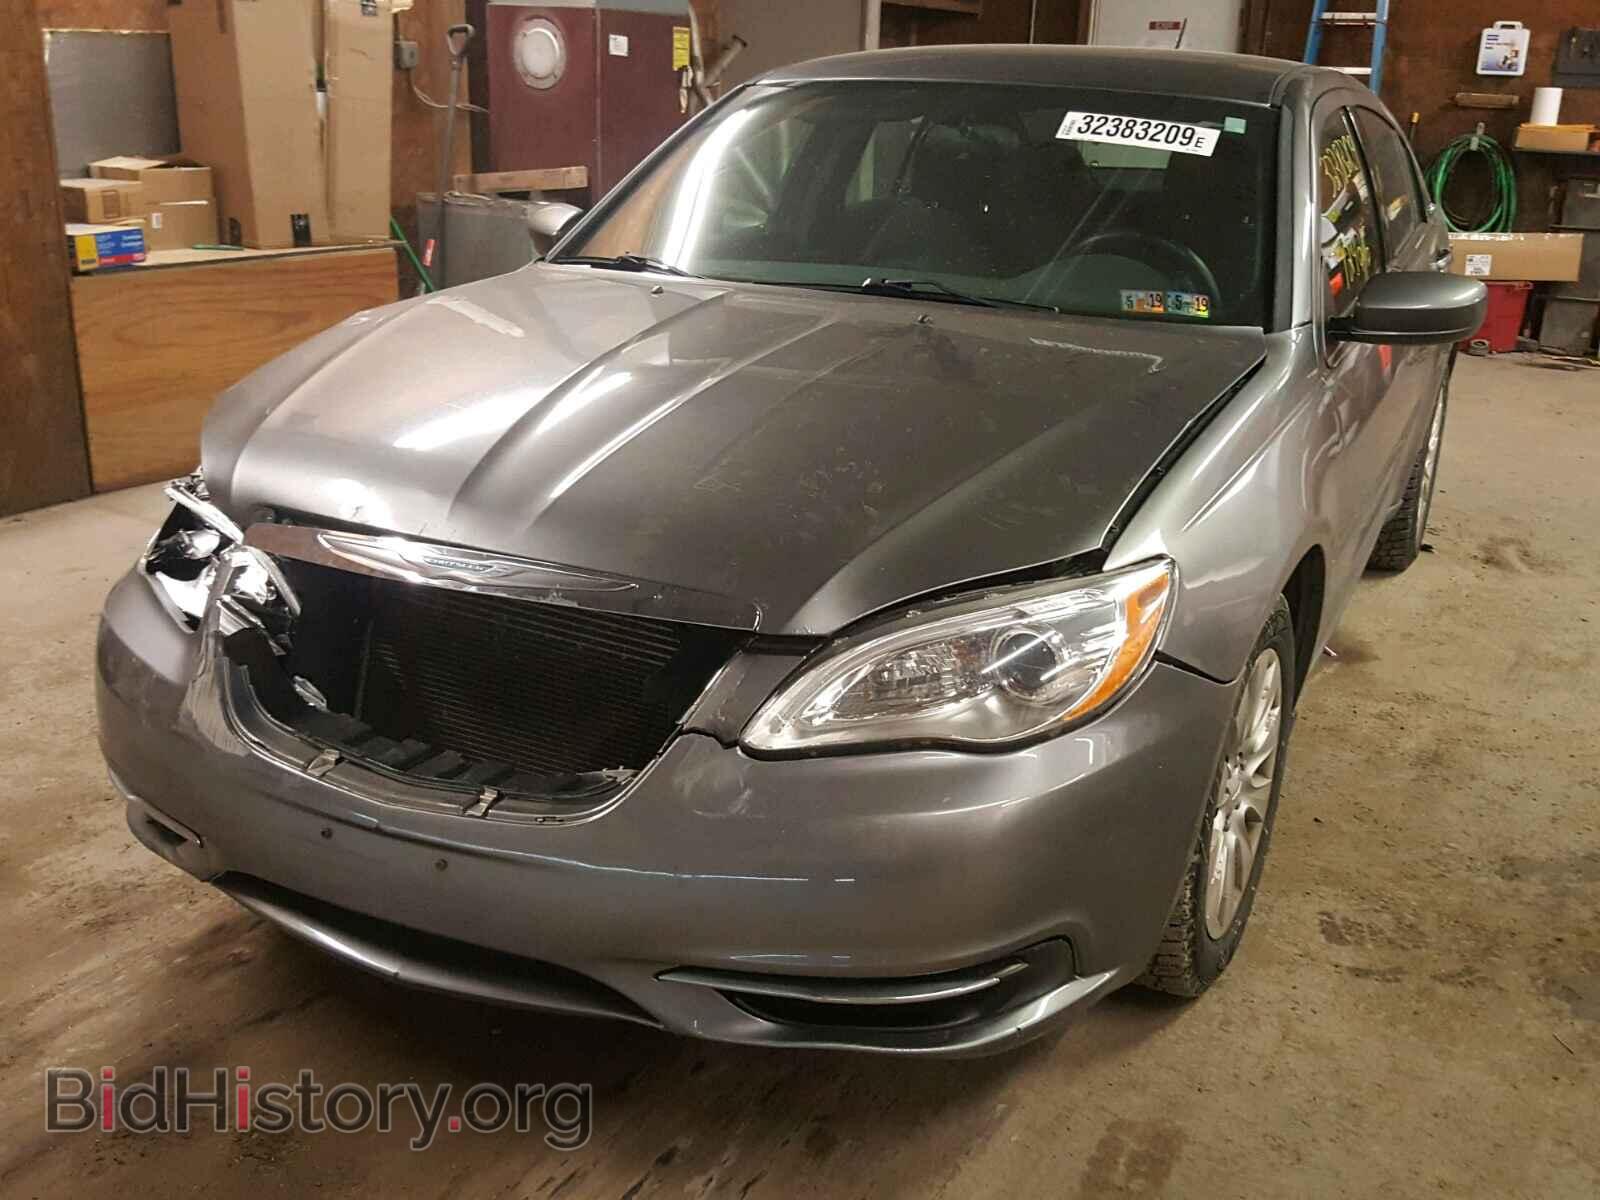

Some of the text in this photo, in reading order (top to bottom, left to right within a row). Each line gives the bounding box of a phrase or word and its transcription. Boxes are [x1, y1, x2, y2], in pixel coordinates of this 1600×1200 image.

[1077, 114, 1196, 146] 32383209
[1194, 137, 1206, 148] E
[1149, 293, 1162, 308] 19
[1195, 296, 1208, 312] 19
